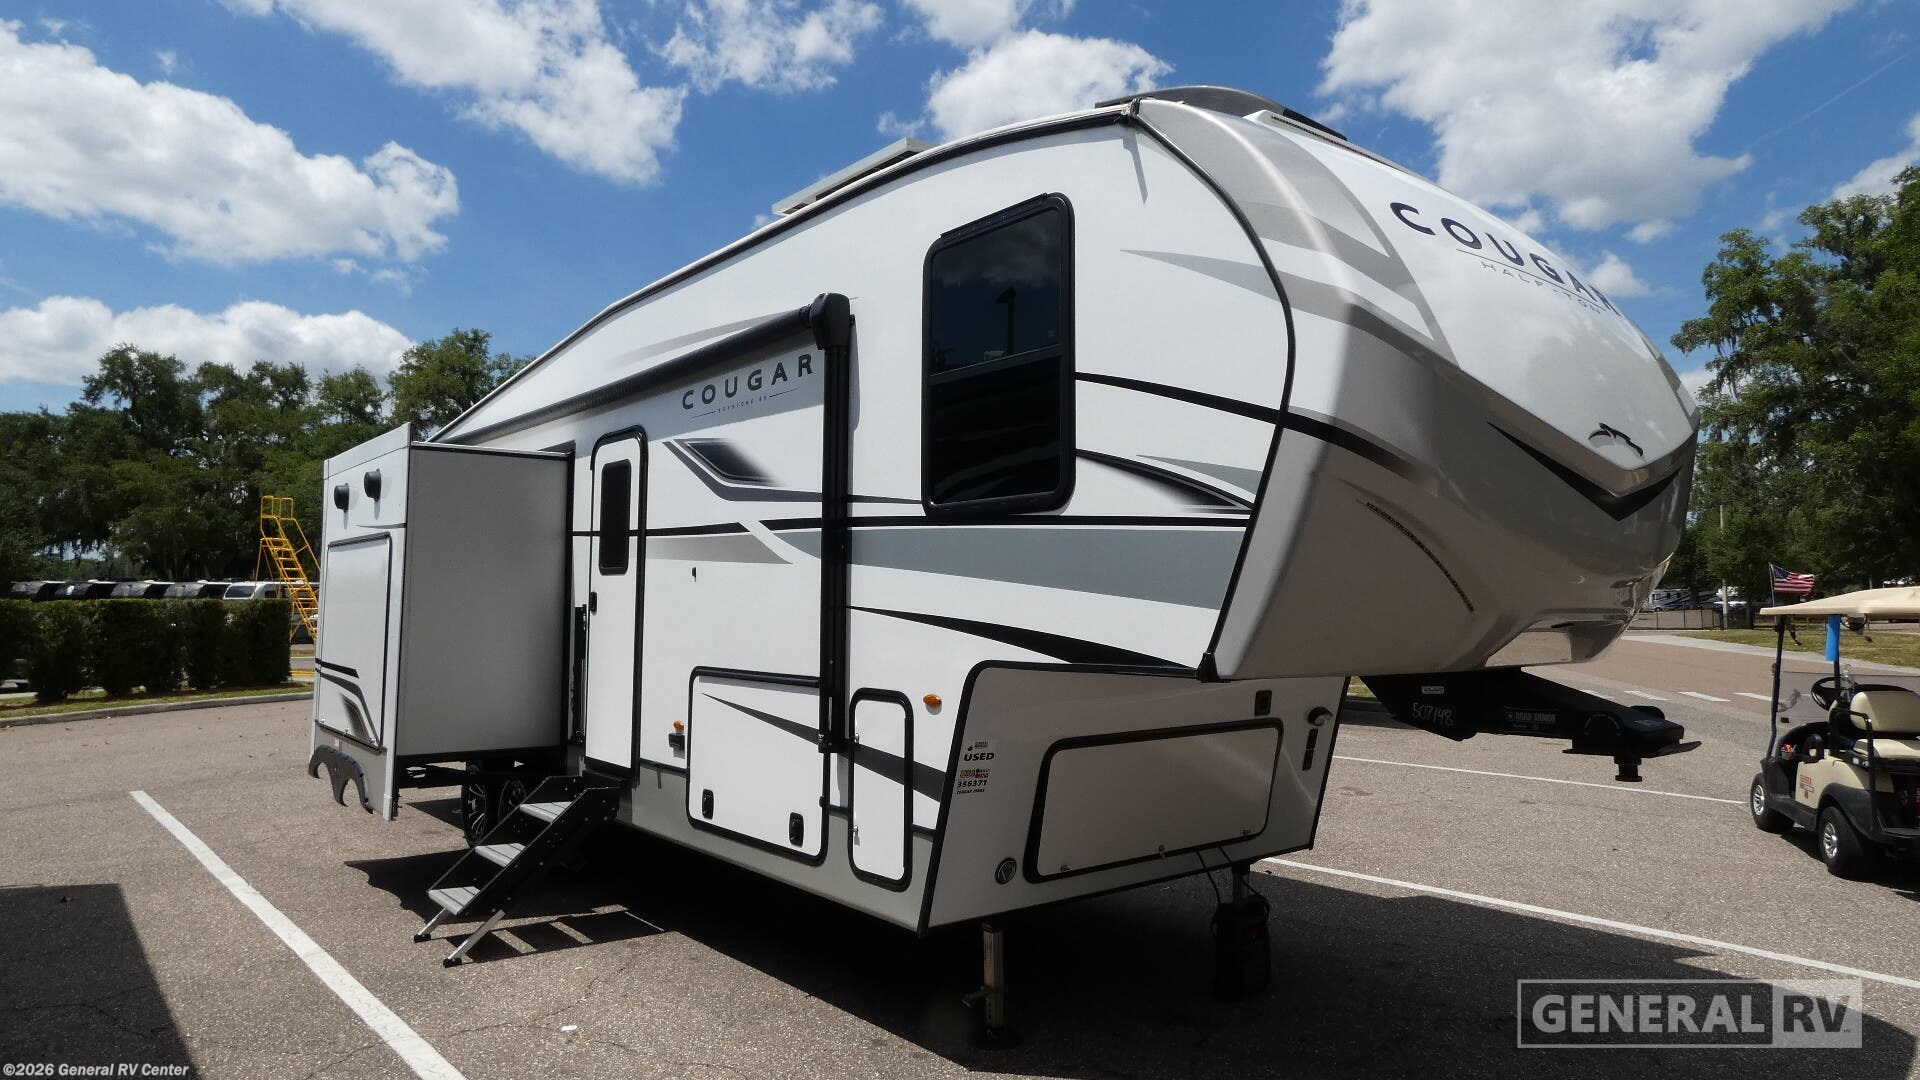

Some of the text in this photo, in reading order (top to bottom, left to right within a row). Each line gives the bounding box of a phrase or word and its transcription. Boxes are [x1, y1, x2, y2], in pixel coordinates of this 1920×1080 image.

[1390, 202, 1621, 316] COUGAR
[682, 353, 814, 410] COUGAR
[963, 752, 995, 761] USED
